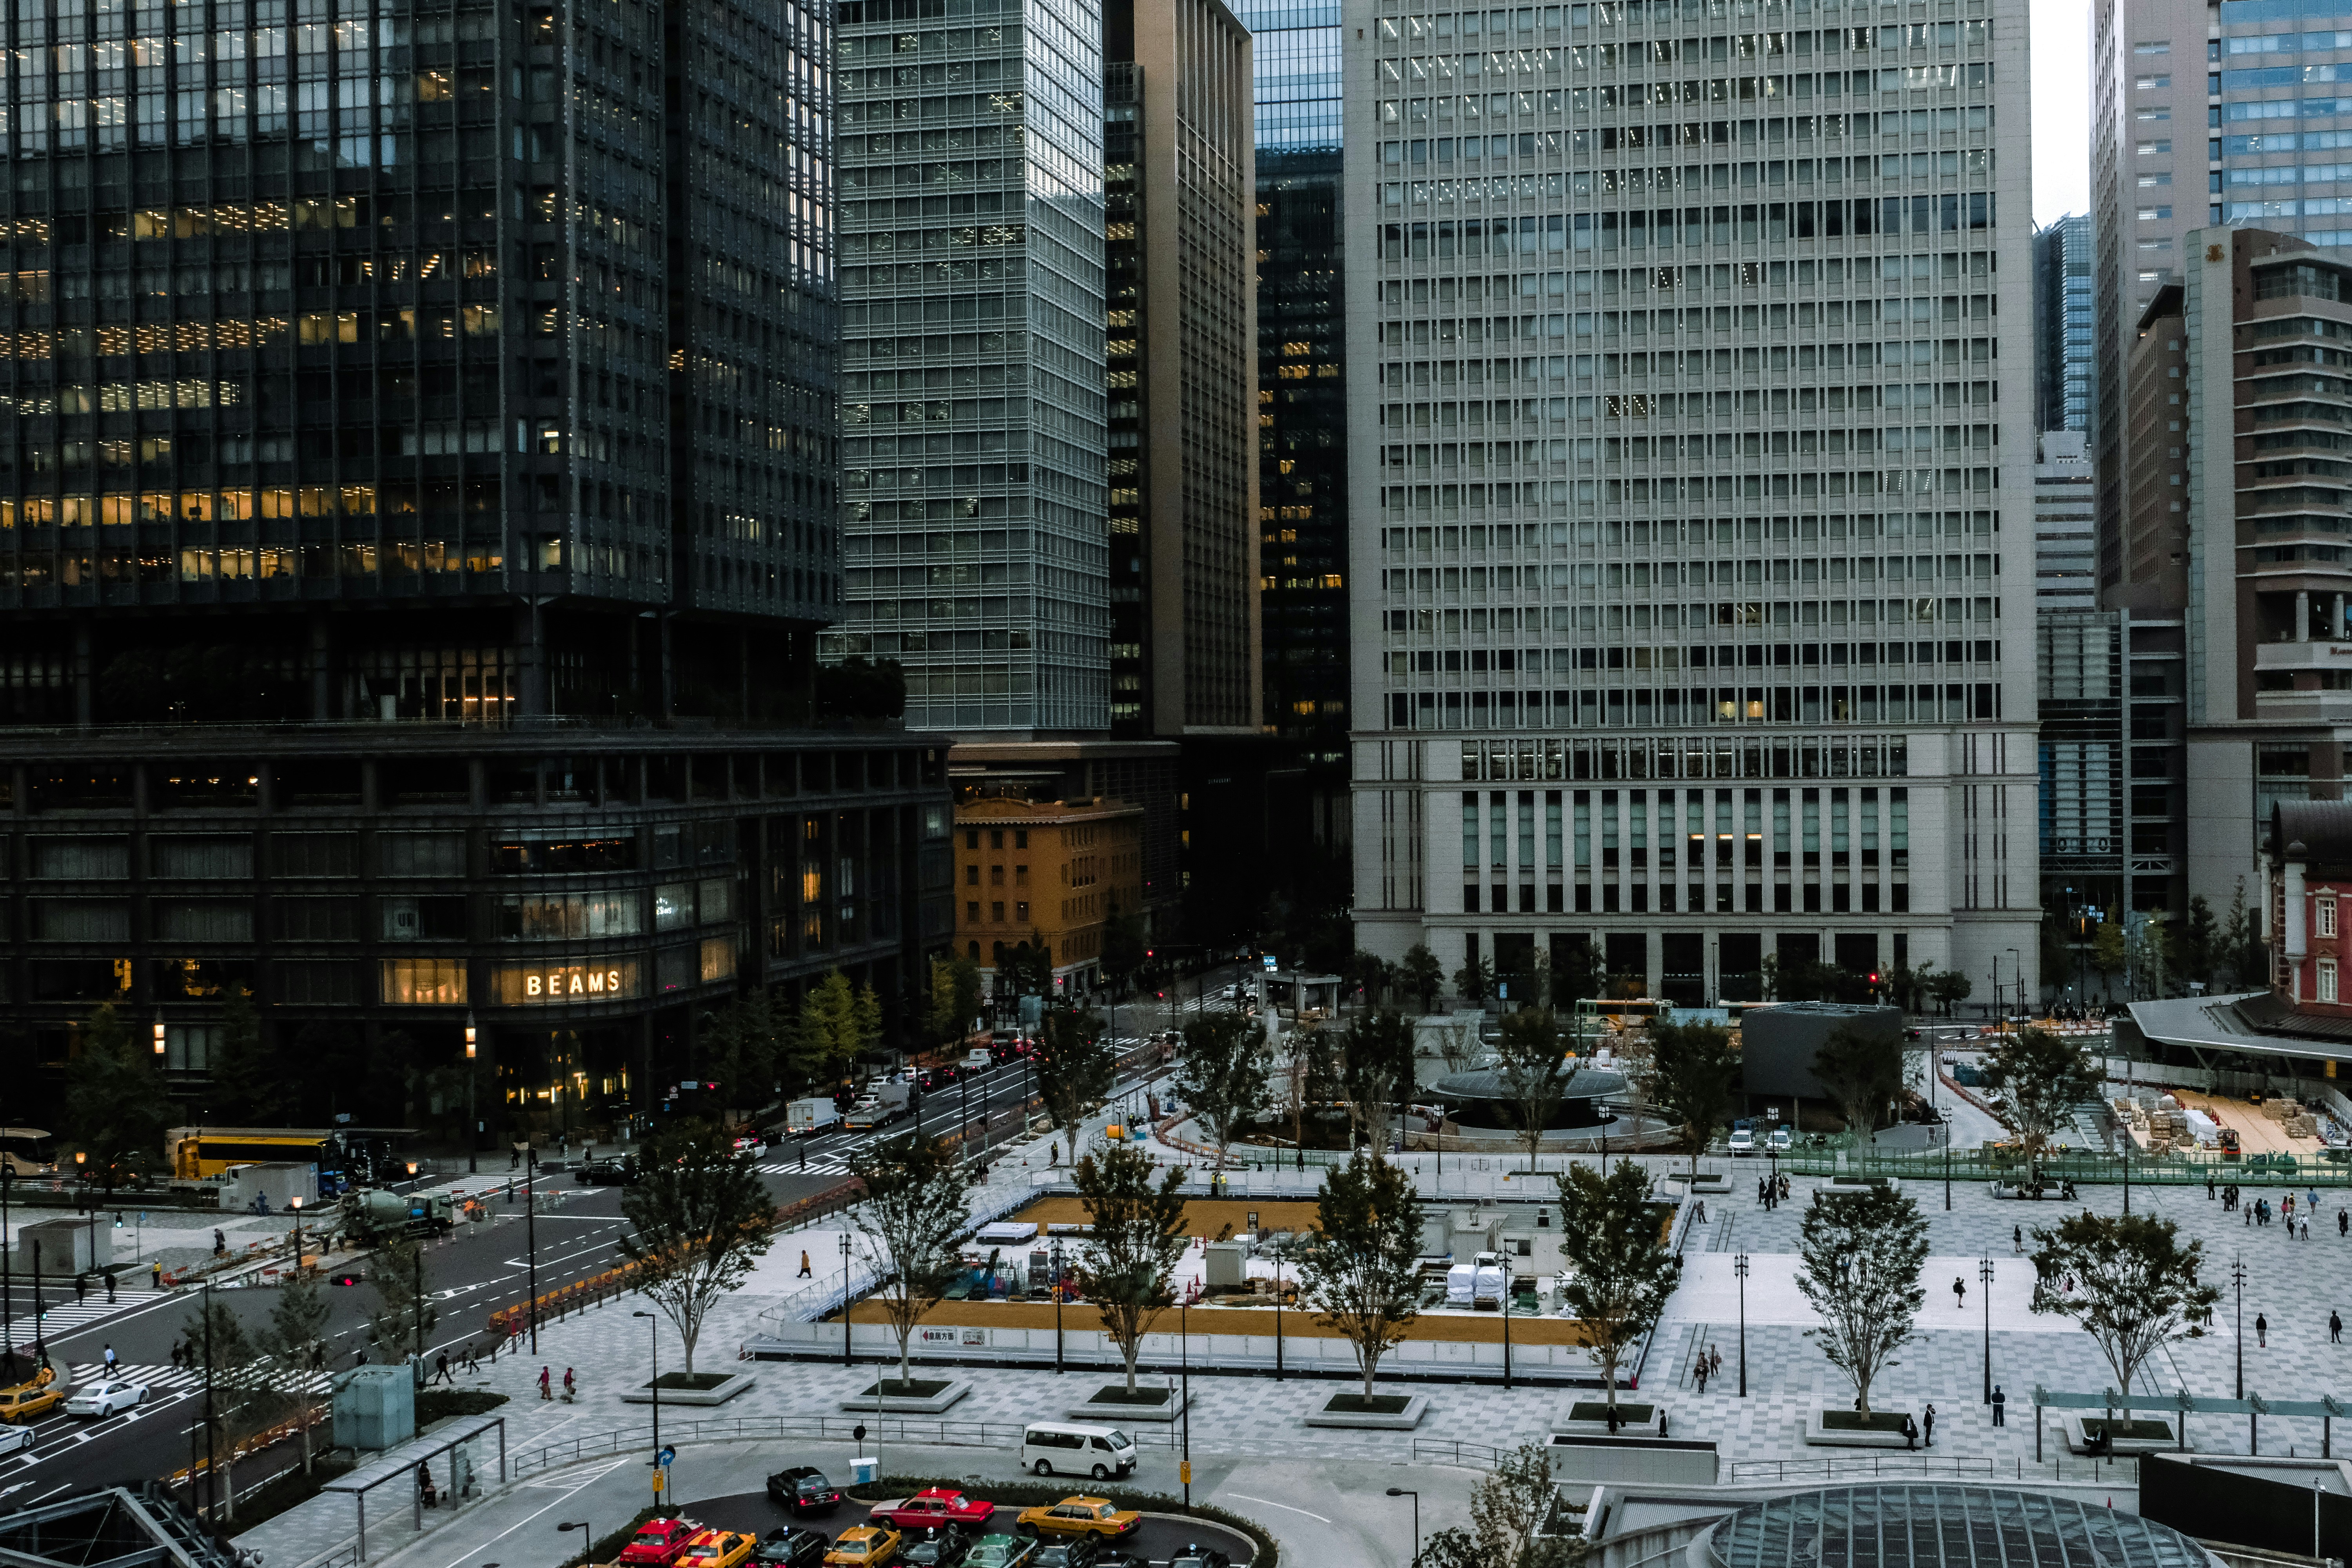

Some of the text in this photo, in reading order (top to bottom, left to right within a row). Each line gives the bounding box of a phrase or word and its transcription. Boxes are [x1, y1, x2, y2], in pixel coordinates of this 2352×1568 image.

[527, 971, 619, 996] BEAMS
[929, 1332, 954, 1340] 皇居方面
